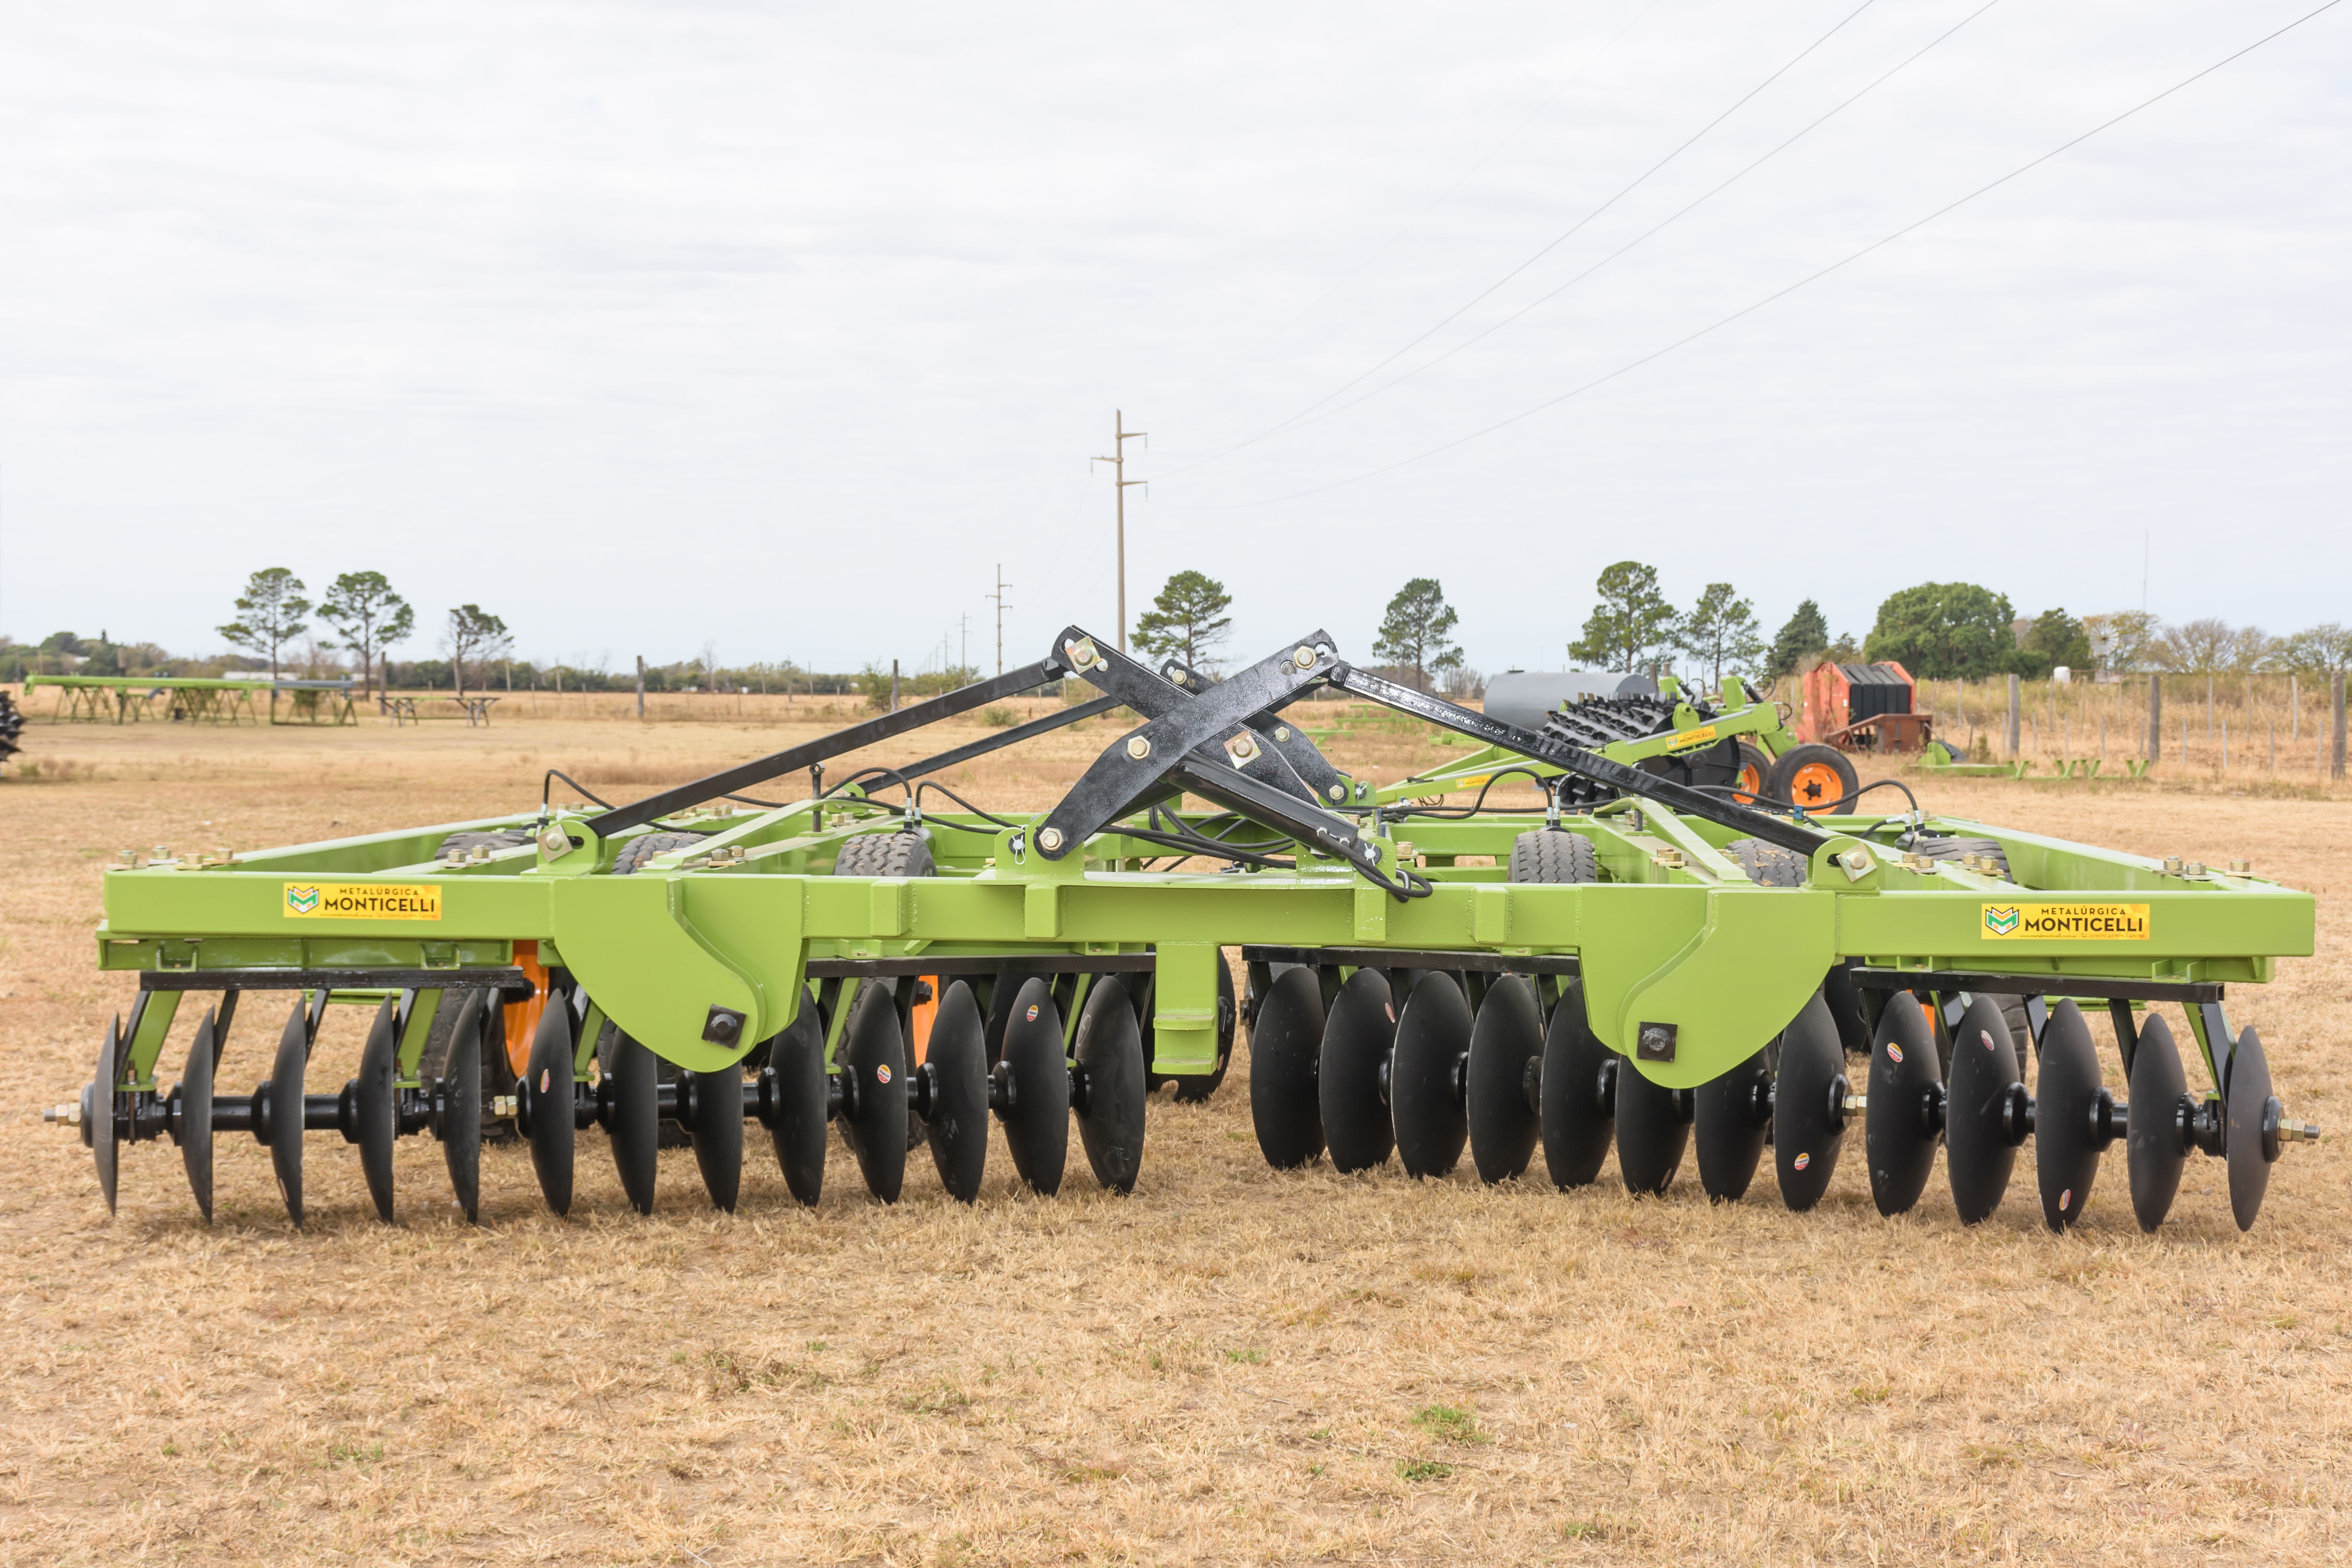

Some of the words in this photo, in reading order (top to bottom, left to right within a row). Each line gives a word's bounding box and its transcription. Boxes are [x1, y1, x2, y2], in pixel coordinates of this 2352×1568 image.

[340, 887, 418, 895] METALÚRGICA
[325, 897, 434, 912] MONTICELLI
[2042, 906, 2126, 915] METALÚRGICA
[2025, 918, 2142, 932] MONTICELLI
